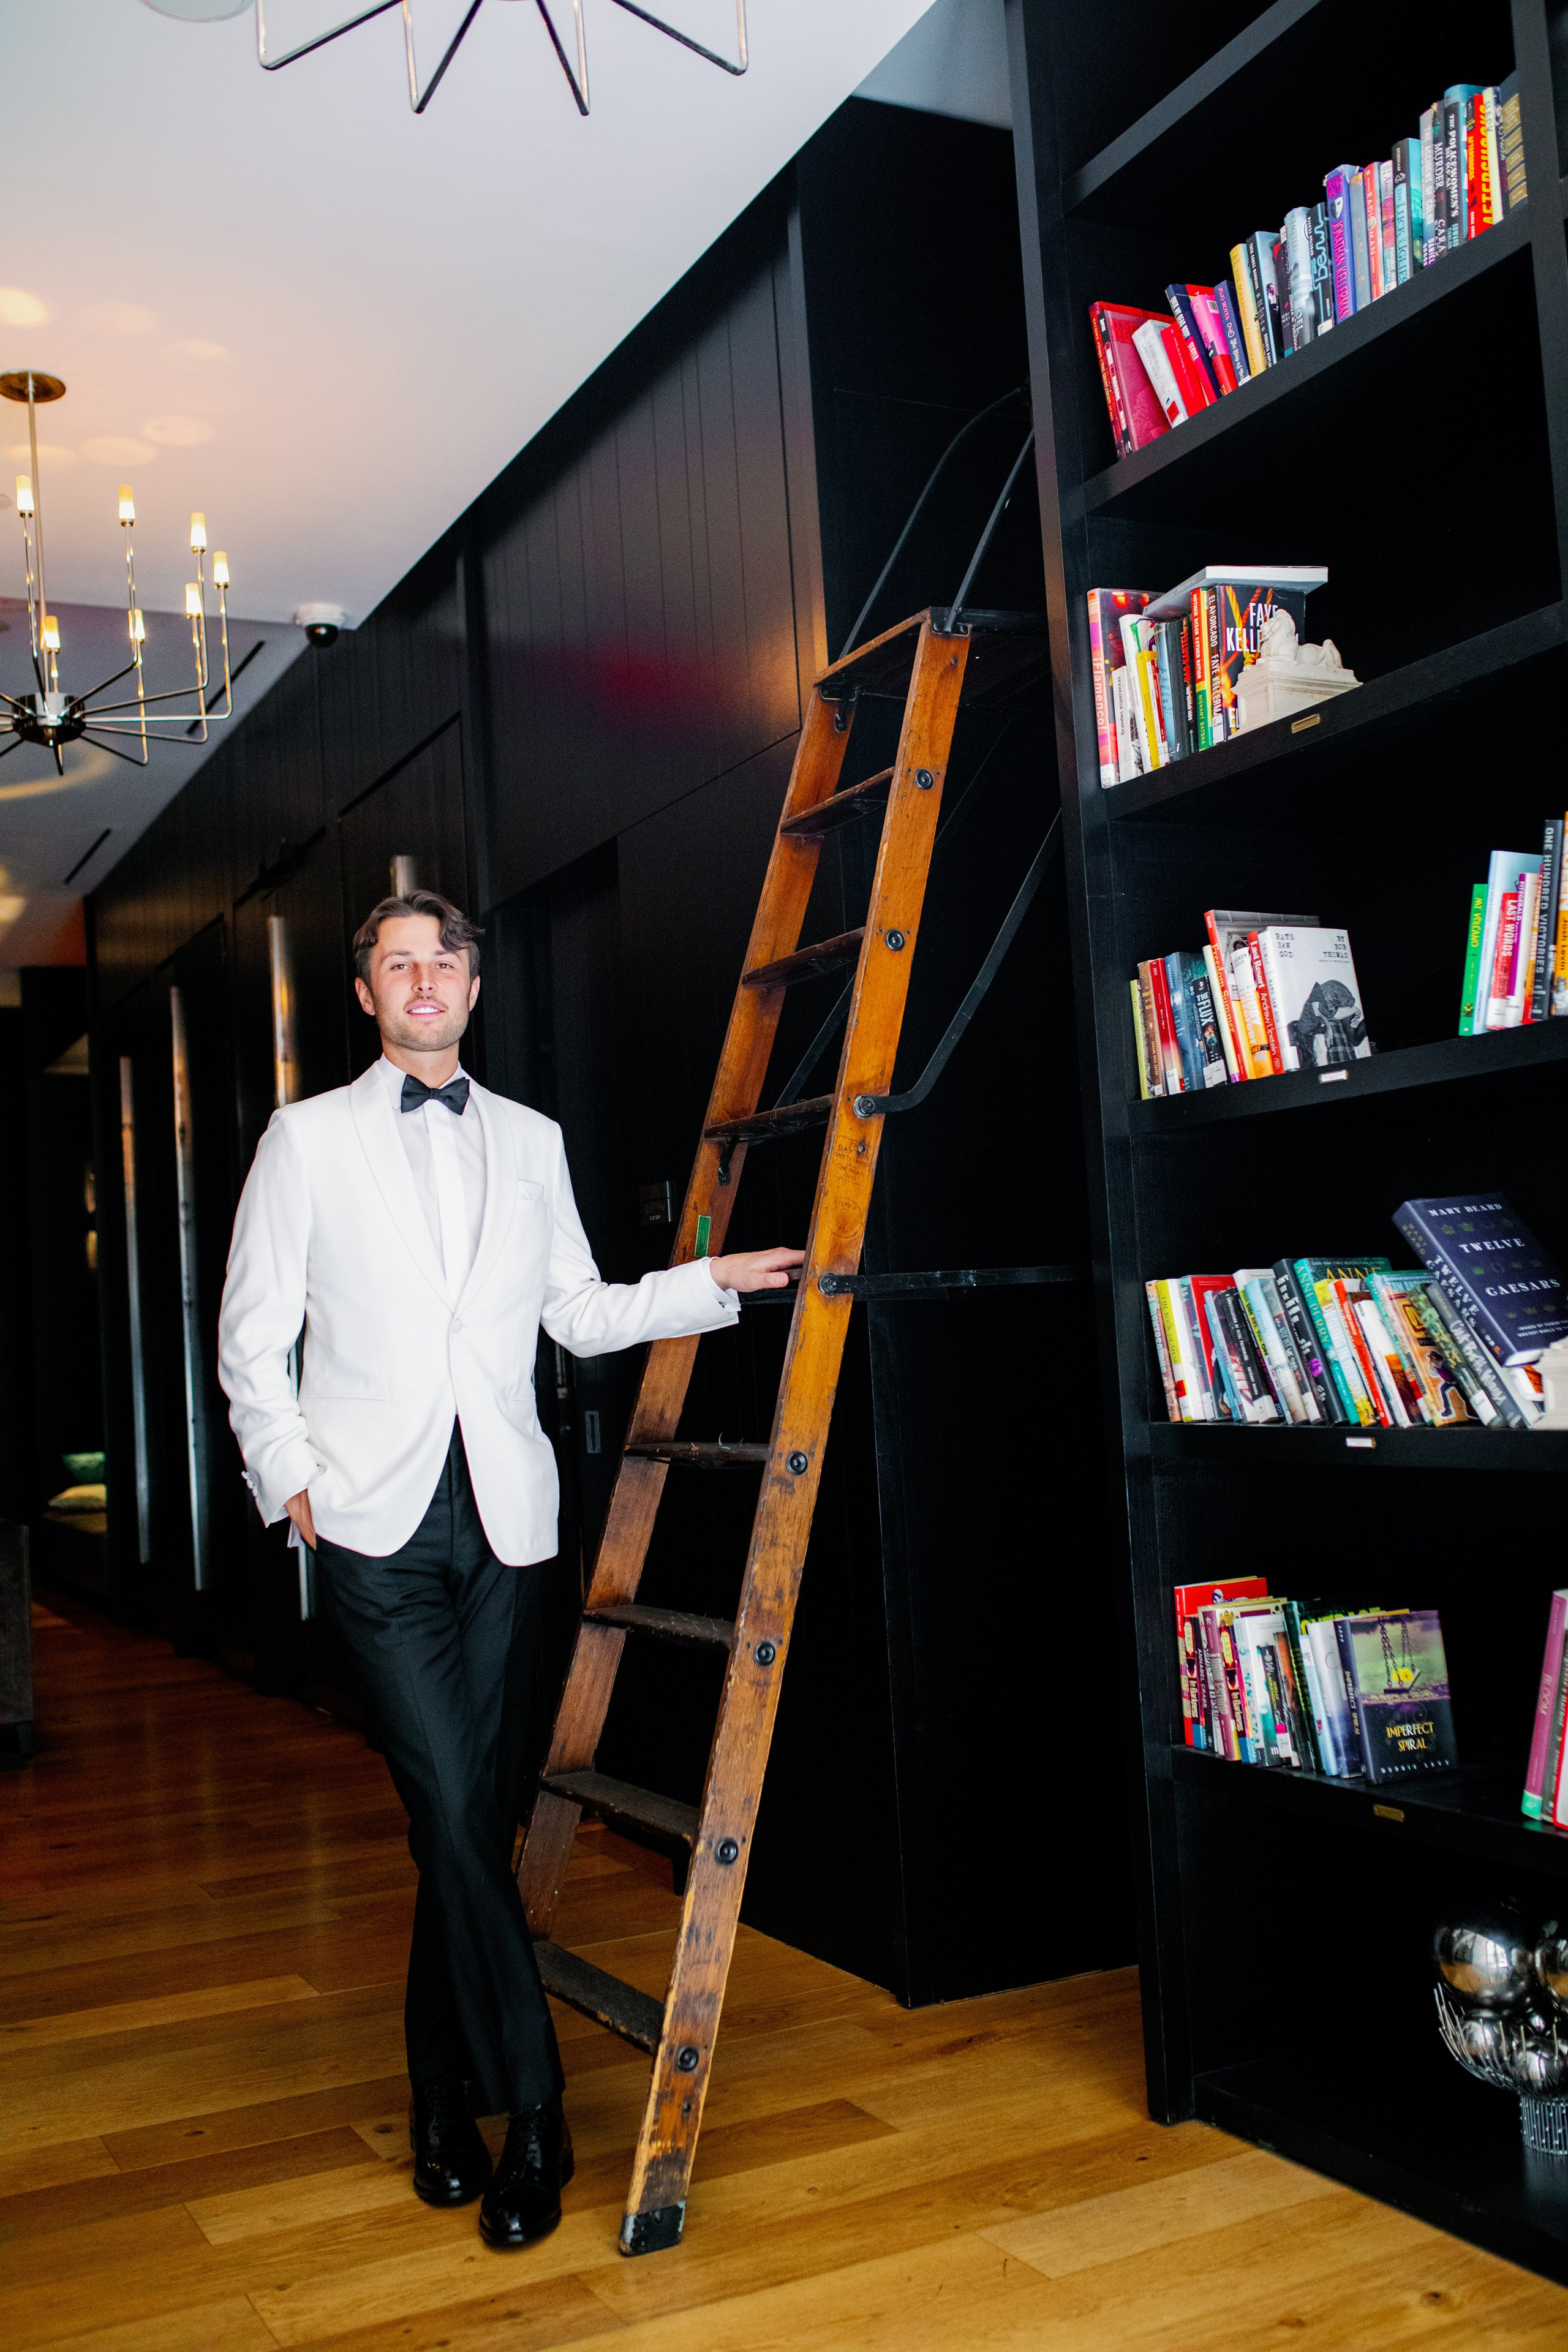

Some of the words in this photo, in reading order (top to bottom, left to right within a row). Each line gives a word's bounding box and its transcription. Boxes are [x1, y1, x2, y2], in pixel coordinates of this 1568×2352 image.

[1434, 142, 1444, 190] MURDER
[1425, 186, 1433, 197] OF
[1396, 202, 1407, 235] LUCK
[1332, 220, 1346, 267] JONATHAN
[1438, 219, 1446, 252] CARA
[1397, 238, 1409, 285] UGLIES
[1169, 296, 1179, 309] OVER
[1217, 286, 1226, 301] JOJO
[1336, 265, 1351, 320] KELLERMAN
[1173, 307, 1182, 315] MY
[1176, 314, 1186, 327] DEAD
[1221, 301, 1231, 320] MOYES
[1180, 325, 1191, 339] BODY
[1237, 285, 1248, 326] MARATHON
[1245, 328, 1257, 371] CONSPIRACY
[1141, 344, 1154, 366] LAWSON
[1150, 366, 1160, 381] ROBY
[1209, 595, 1215, 604] EL
[1093, 658, 1108, 730] ¡Flamenco!
[1544, 827, 1554, 850] ONE
[1541, 854, 1552, 910] HUNDRED
[1474, 897, 1483, 909] MY
[1506, 899, 1518, 926] LAST
[1517, 881, 1526, 921] FITZGERALD
[1471, 912, 1482, 948] VOLCANO
[1502, 926, 1515, 957] WORDS
[1536, 914, 1548, 974] VICTORIES
[1250, 941, 1261, 960] Last
[1253, 959, 1265, 989] Resort
[1196, 993, 1209, 1001] THE
[1260, 992, 1272, 1023] Andrew
[1197, 1000, 1215, 1027] FLUX
[1265, 1024, 1278, 1055] Lipstein
[1428, 1207, 1461, 1216] MARY
[1464, 1203, 1502, 1213] BEARD
[1458, 1238, 1526, 1253] TWELVE
[1425, 1259, 1477, 1328] CAESARS
[1431, 1253, 1480, 1317] TWELVE
[1486, 1279, 1561, 1297] CAESARS
[1226, 1297, 1238, 1324] CONSTELLATION
[1295, 1264, 1315, 1300] ANNE
[1309, 1303, 1330, 1345] PERRY
[1169, 1333, 1174, 1343] OF
[1321, 1302, 1346, 1348] DEALING
[1261, 1343, 1269, 1356] ON
[1337, 1346, 1350, 1360] IN
[1341, 1359, 1365, 1404] DREAMS
[1275, 1402, 1284, 1418] 2013
[1196, 1648, 1205, 1682] ANNABEL
[1190, 1687, 1199, 1718] Darkness
[1344, 1670, 1357, 1710] IMPERFECT
[1352, 1711, 1360, 1736] SPIRAL
[1539, 1673, 1553, 1715] BLOOM
[1232, 1699, 1245, 1732] Darkness
[1386, 1722, 1434, 1738] IMPERFECT
[1398, 1736, 1428, 1752] SPIRAL
[1381, 1763, 1417, 1774] DEBBIE
[1424, 1759, 1450, 1769] LEVY
